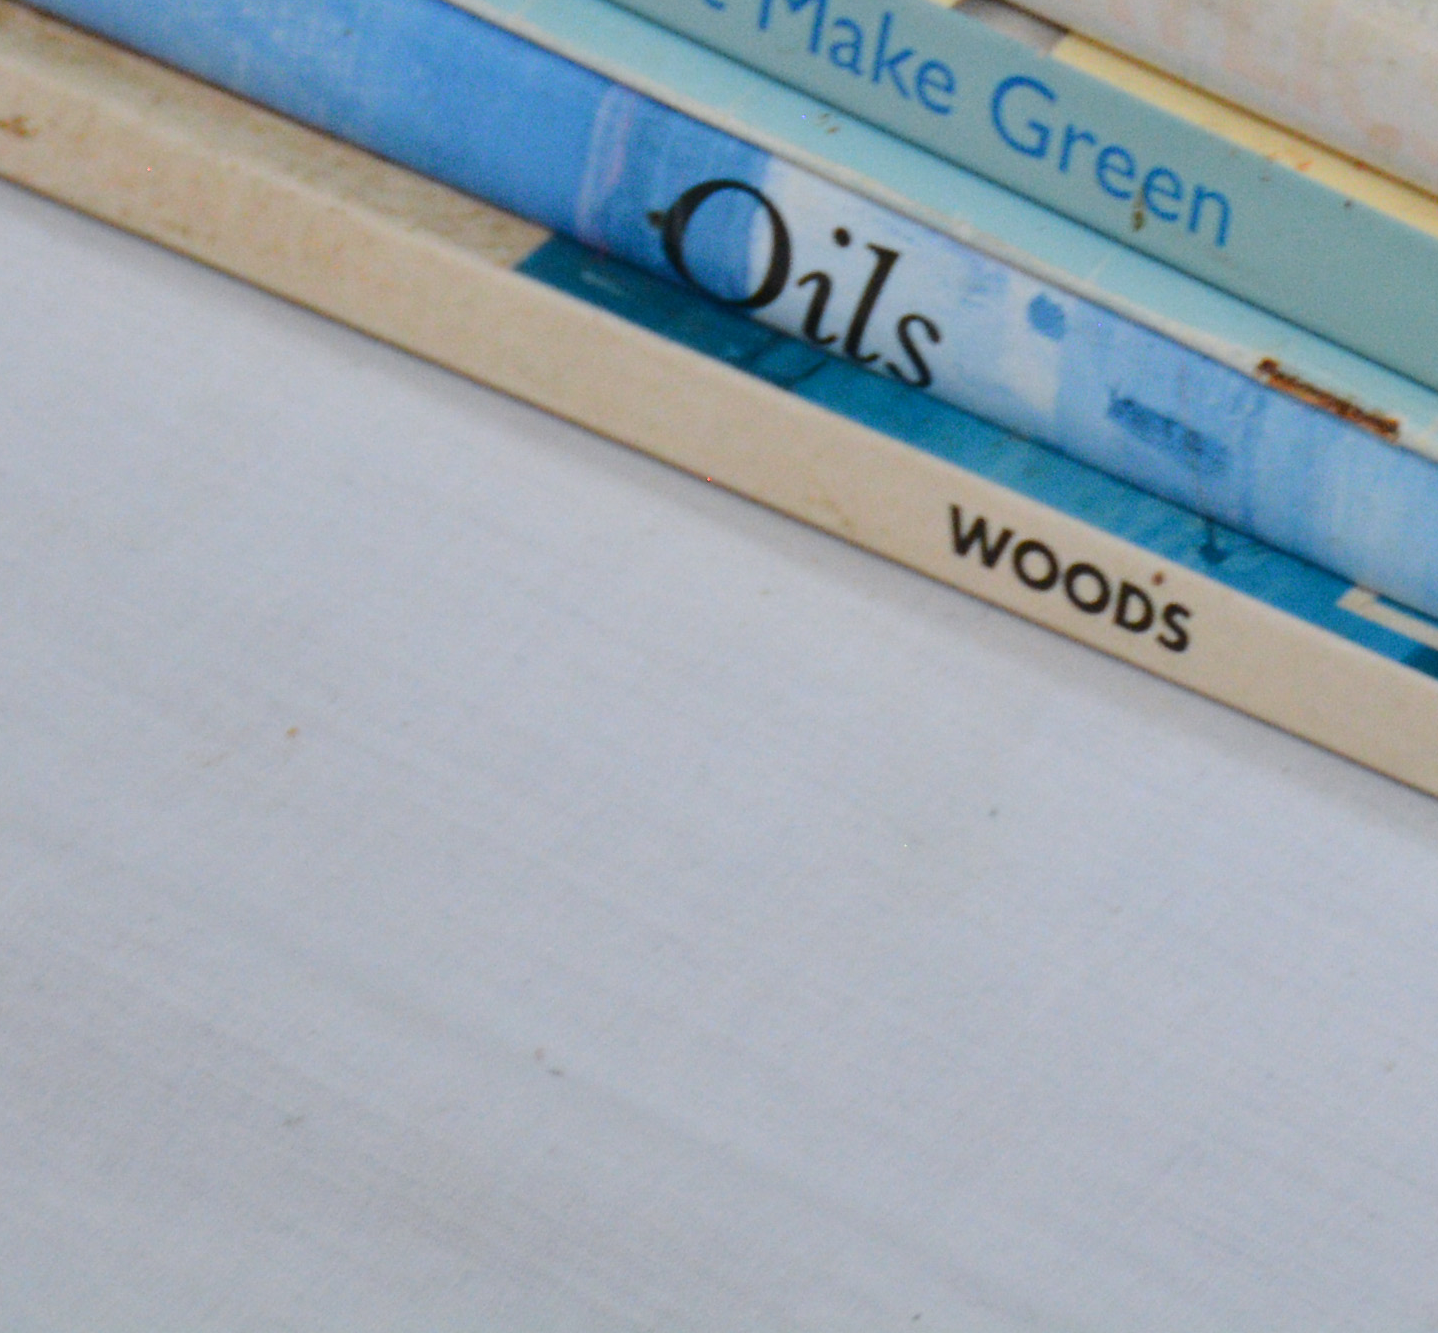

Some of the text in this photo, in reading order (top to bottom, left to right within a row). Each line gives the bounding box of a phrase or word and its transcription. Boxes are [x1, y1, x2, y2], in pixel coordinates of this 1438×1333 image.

[990, 74, 1234, 250] Green
[662, 179, 943, 389] Oils
[948, 503, 1192, 654] WOODS
